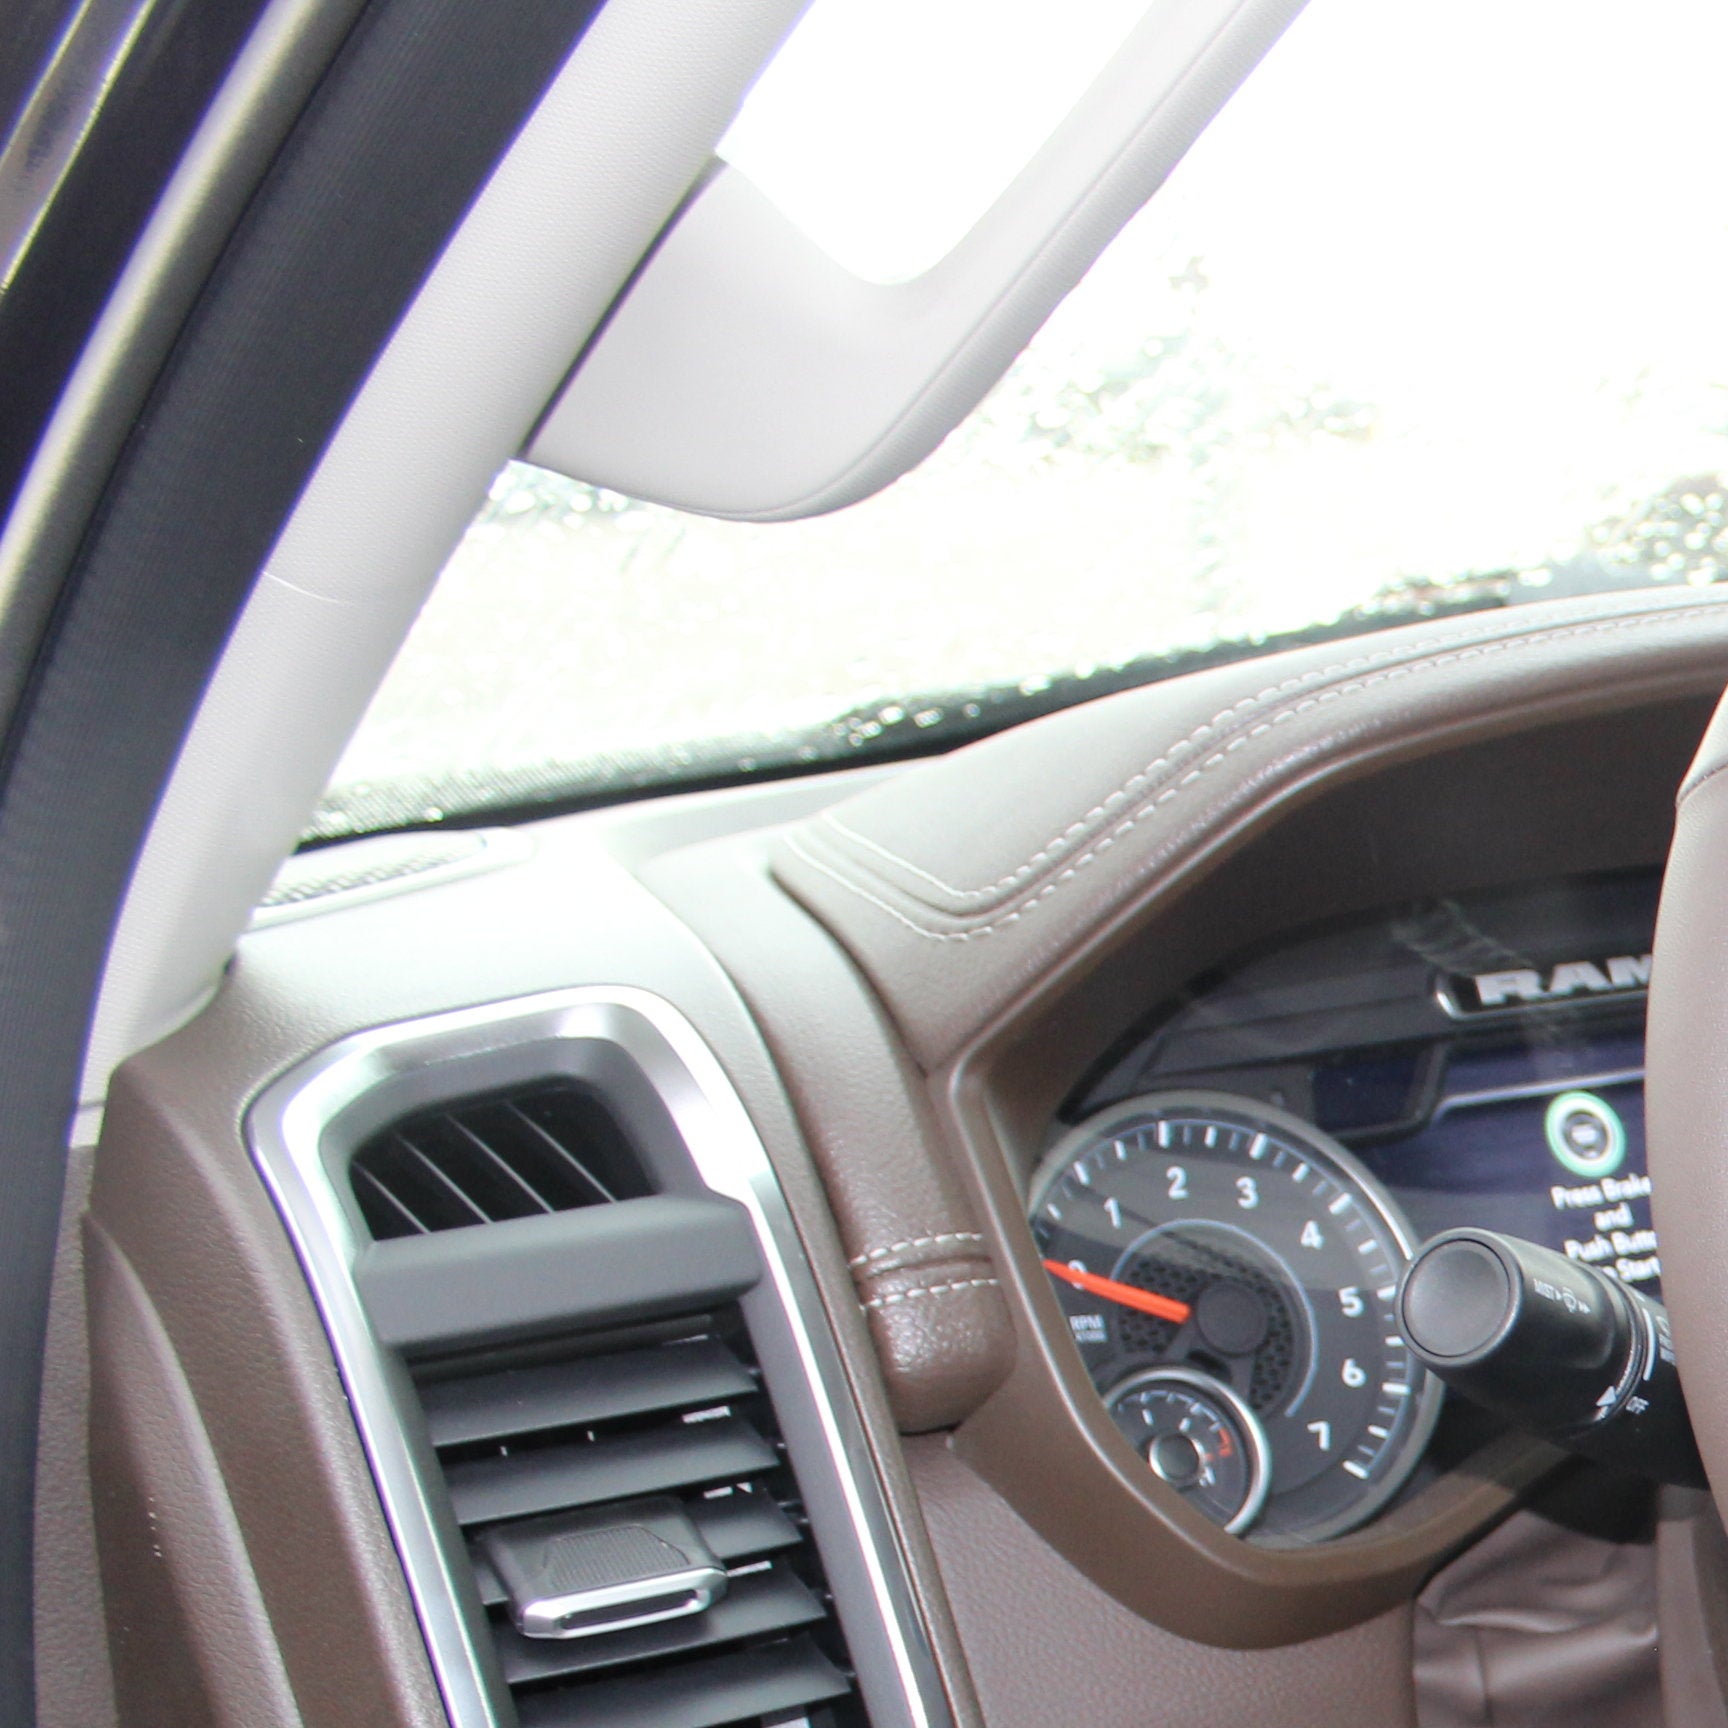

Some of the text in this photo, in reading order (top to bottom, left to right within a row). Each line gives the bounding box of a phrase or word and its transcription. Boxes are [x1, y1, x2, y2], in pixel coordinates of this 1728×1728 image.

[1475, 954, 1652, 1005] RAM
[1167, 1166, 1188, 1198] 2
[1236, 1177, 1259, 1208] 3
[1104, 1198, 1121, 1228] 1
[1301, 1221, 1323, 1249] 4
[1339, 1287, 1363, 1316] 5
[1342, 1359, 1365, 1386] 6
[1308, 1422, 1330, 1449] 7
